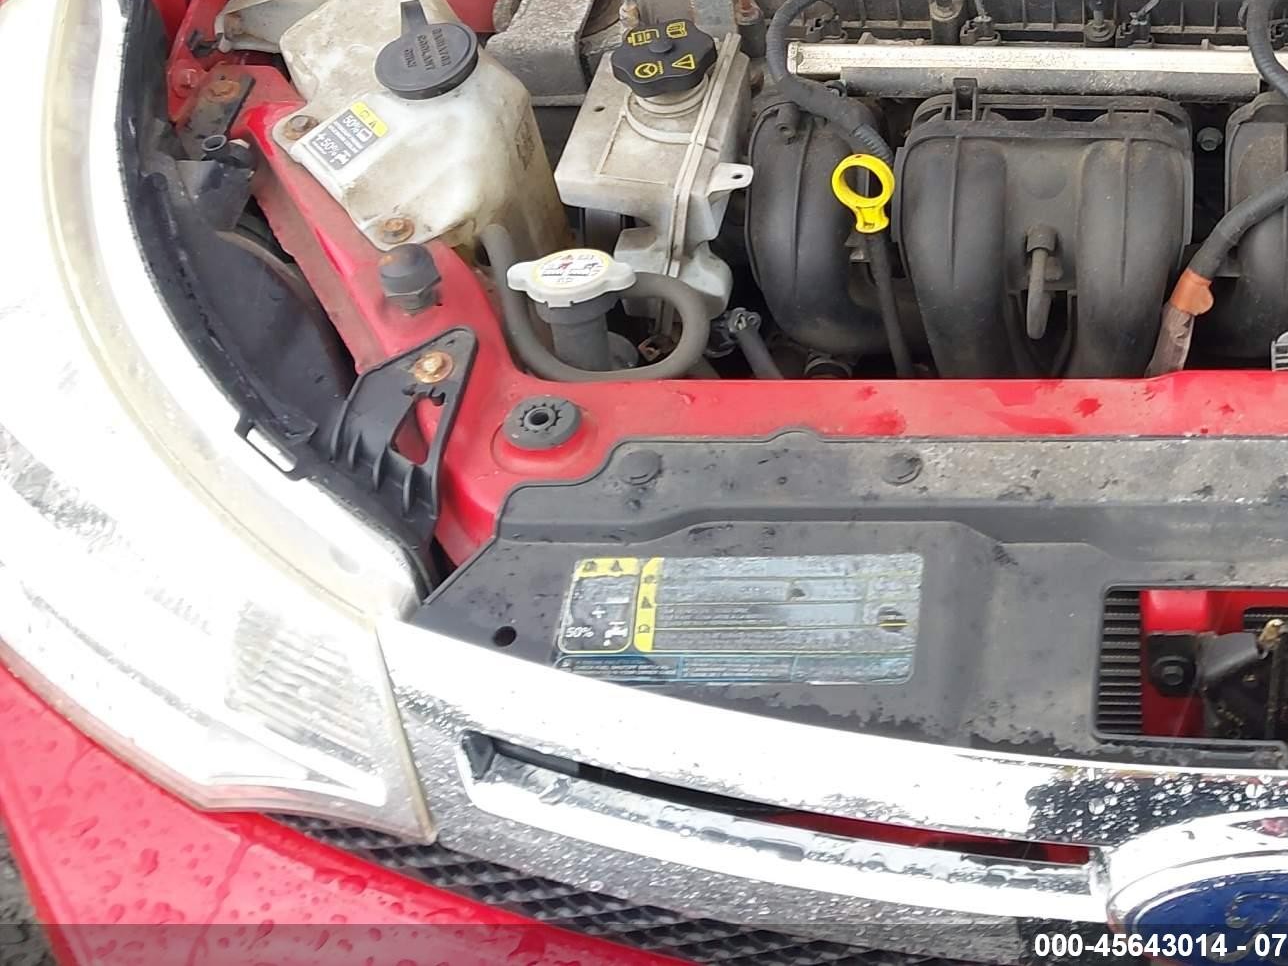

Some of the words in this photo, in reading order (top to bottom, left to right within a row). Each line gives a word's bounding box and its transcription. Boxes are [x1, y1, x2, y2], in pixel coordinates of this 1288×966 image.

[416, 34, 436, 71] COOLANT
[343, 114, 361, 135] 50%
[565, 626, 594, 638] 50%
